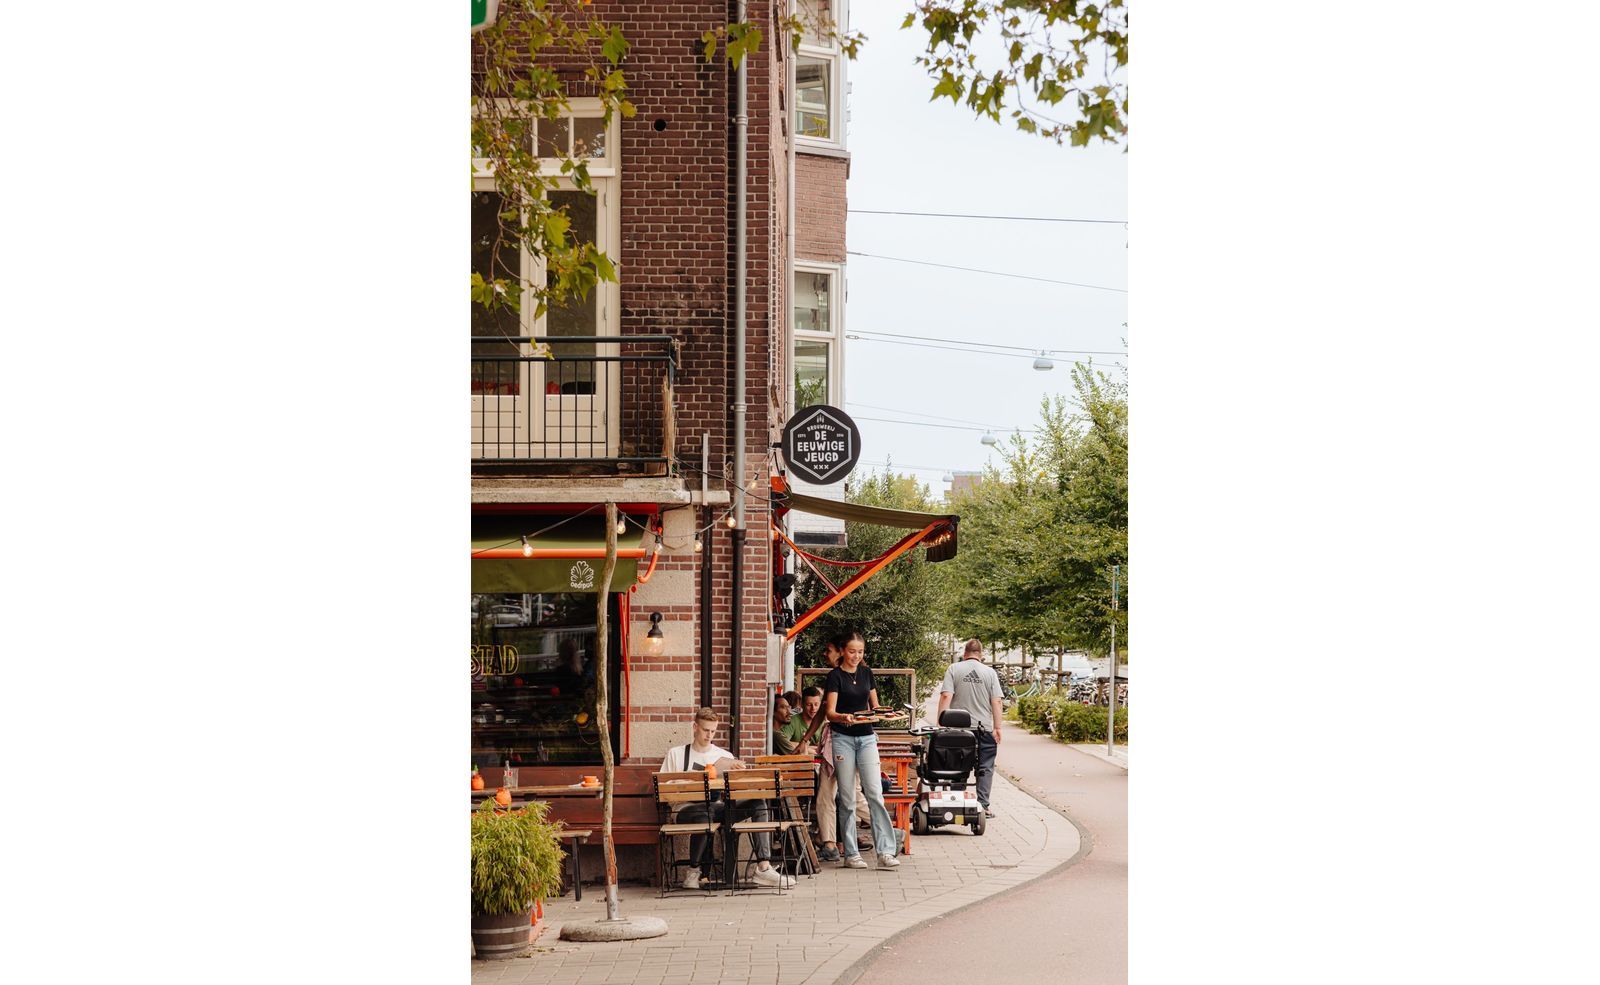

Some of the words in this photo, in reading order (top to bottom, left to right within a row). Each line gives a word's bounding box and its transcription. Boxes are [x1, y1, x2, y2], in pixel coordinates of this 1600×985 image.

[807, 424, 836, 432] BROUWERIJ
[815, 431, 827, 440] DE
[797, 441, 845, 452] EEUWIGE
[804, 452, 839, 462] JEUGD
[471, 645, 519, 675] STAD
